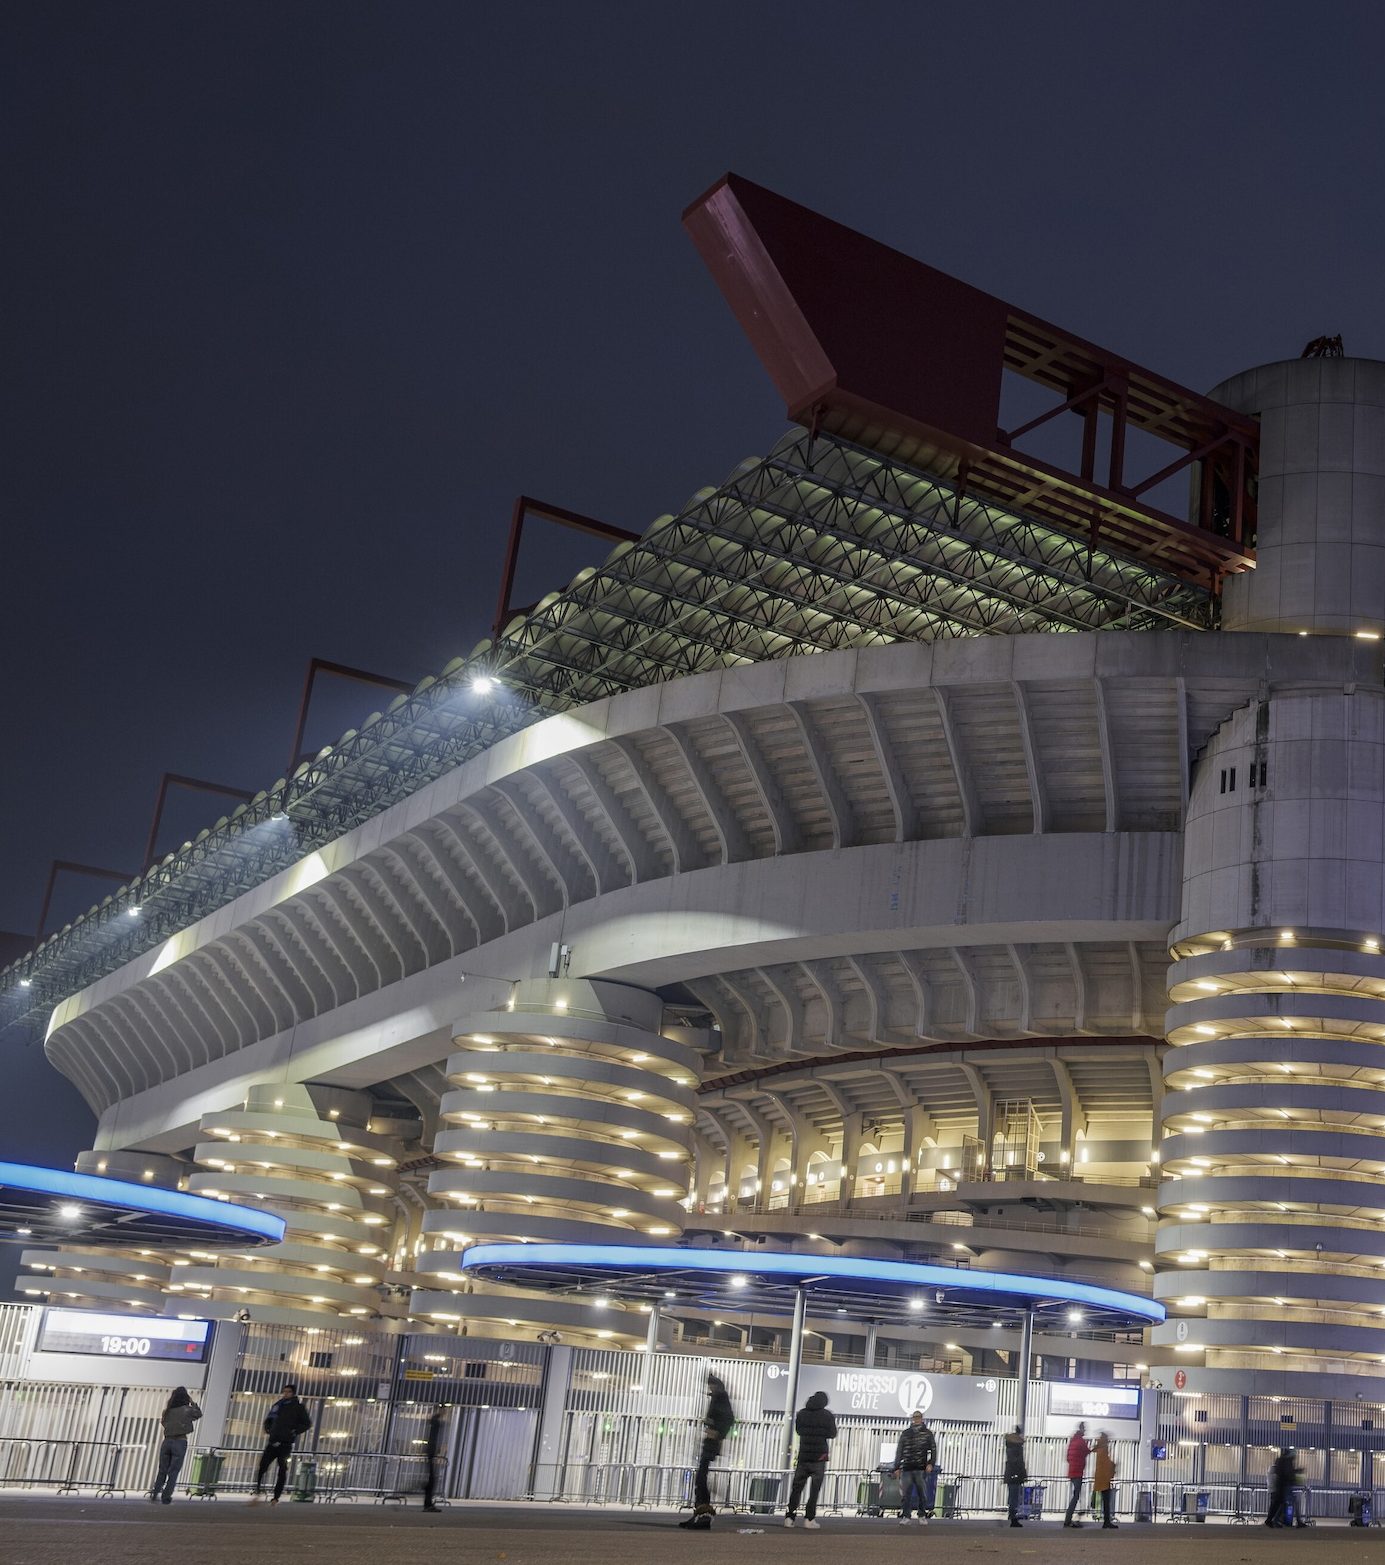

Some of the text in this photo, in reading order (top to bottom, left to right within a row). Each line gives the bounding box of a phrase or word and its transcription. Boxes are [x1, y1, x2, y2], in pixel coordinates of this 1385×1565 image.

[101, 1335, 151, 1355] 19:00
[836, 1373, 897, 1394] INGRESSO
[851, 1392, 880, 1410] GATE
[905, 1379, 926, 1409] 12
